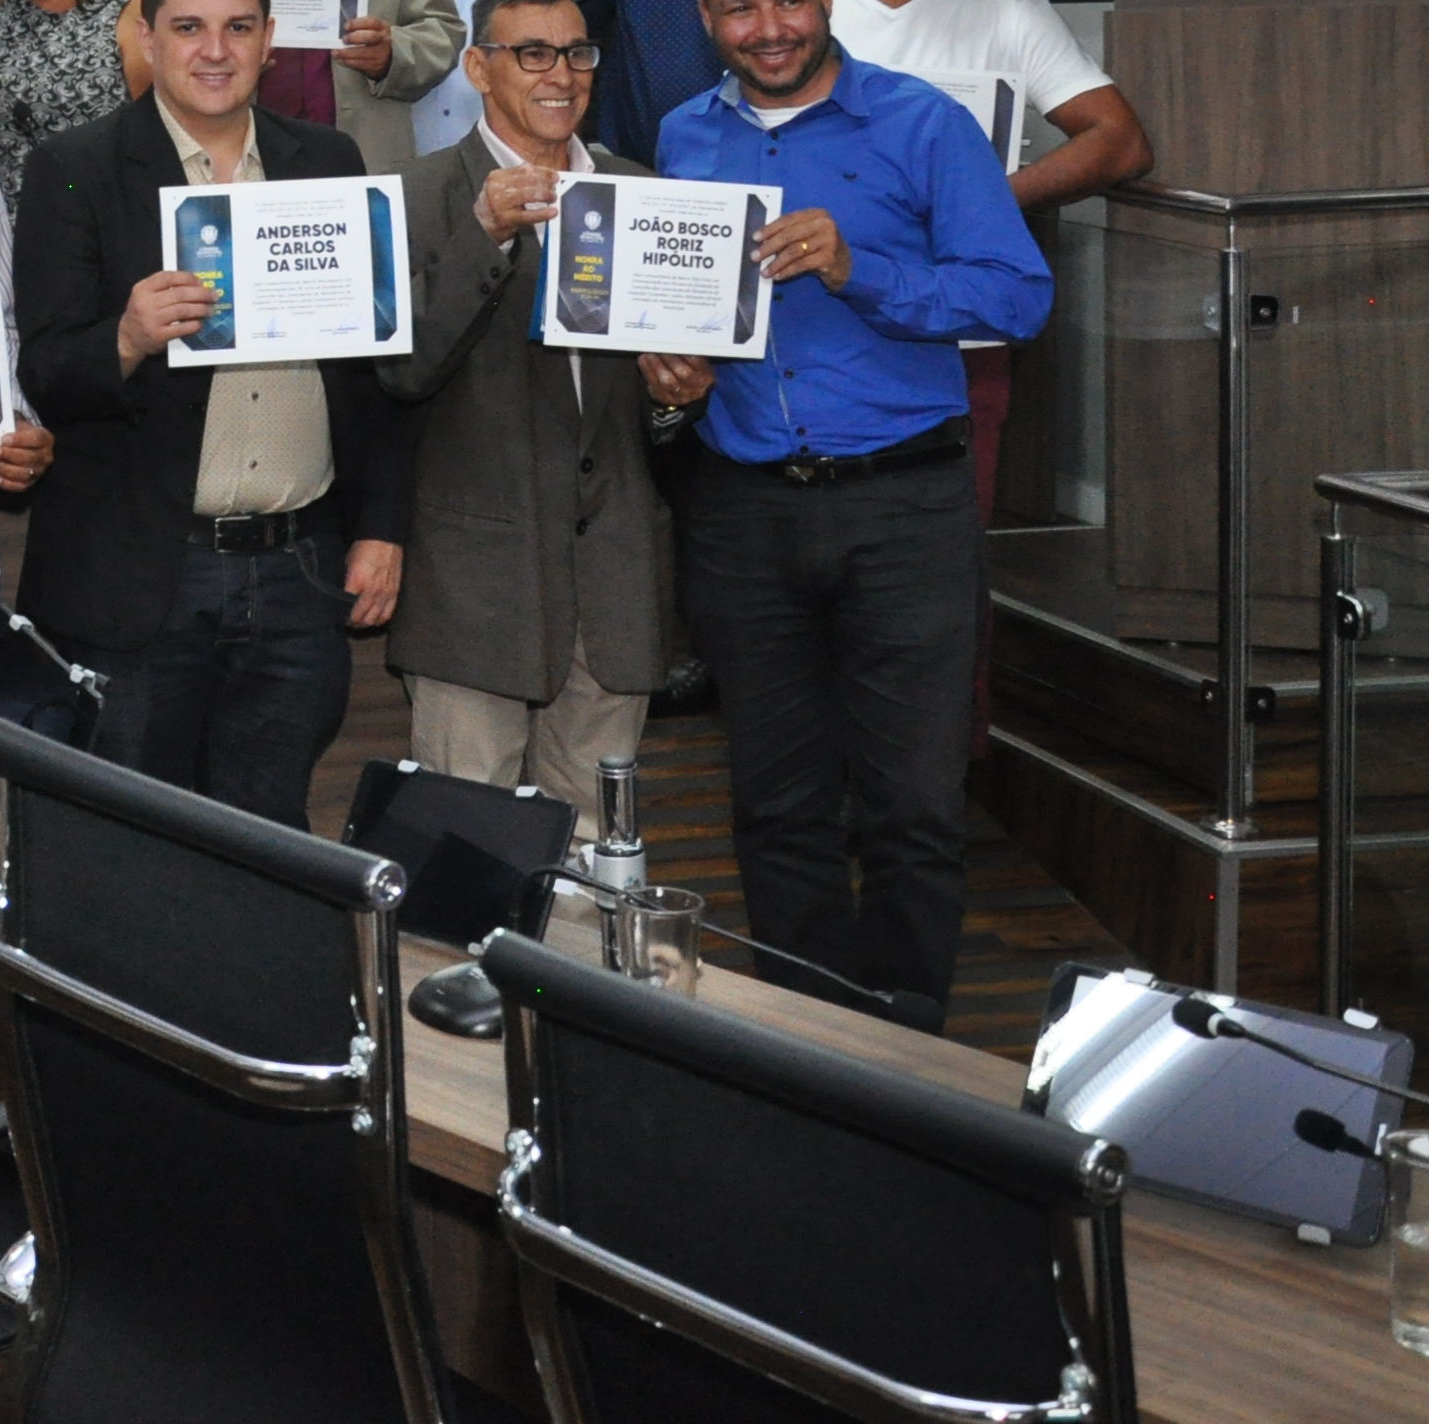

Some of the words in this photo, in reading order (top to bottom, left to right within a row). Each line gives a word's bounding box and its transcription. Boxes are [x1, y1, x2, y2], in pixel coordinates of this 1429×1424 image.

[256, 223, 346, 239] ANDERSON
[629, 217, 674, 233] JOÃO
[678, 222, 732, 238] BOSCO
[270, 240, 335, 255] CARLOS
[657, 237, 703, 252] RORIZ
[267, 259, 290, 272] DA
[295, 257, 339, 271] SILVA
[643, 250, 714, 269] HIPÓLITO
